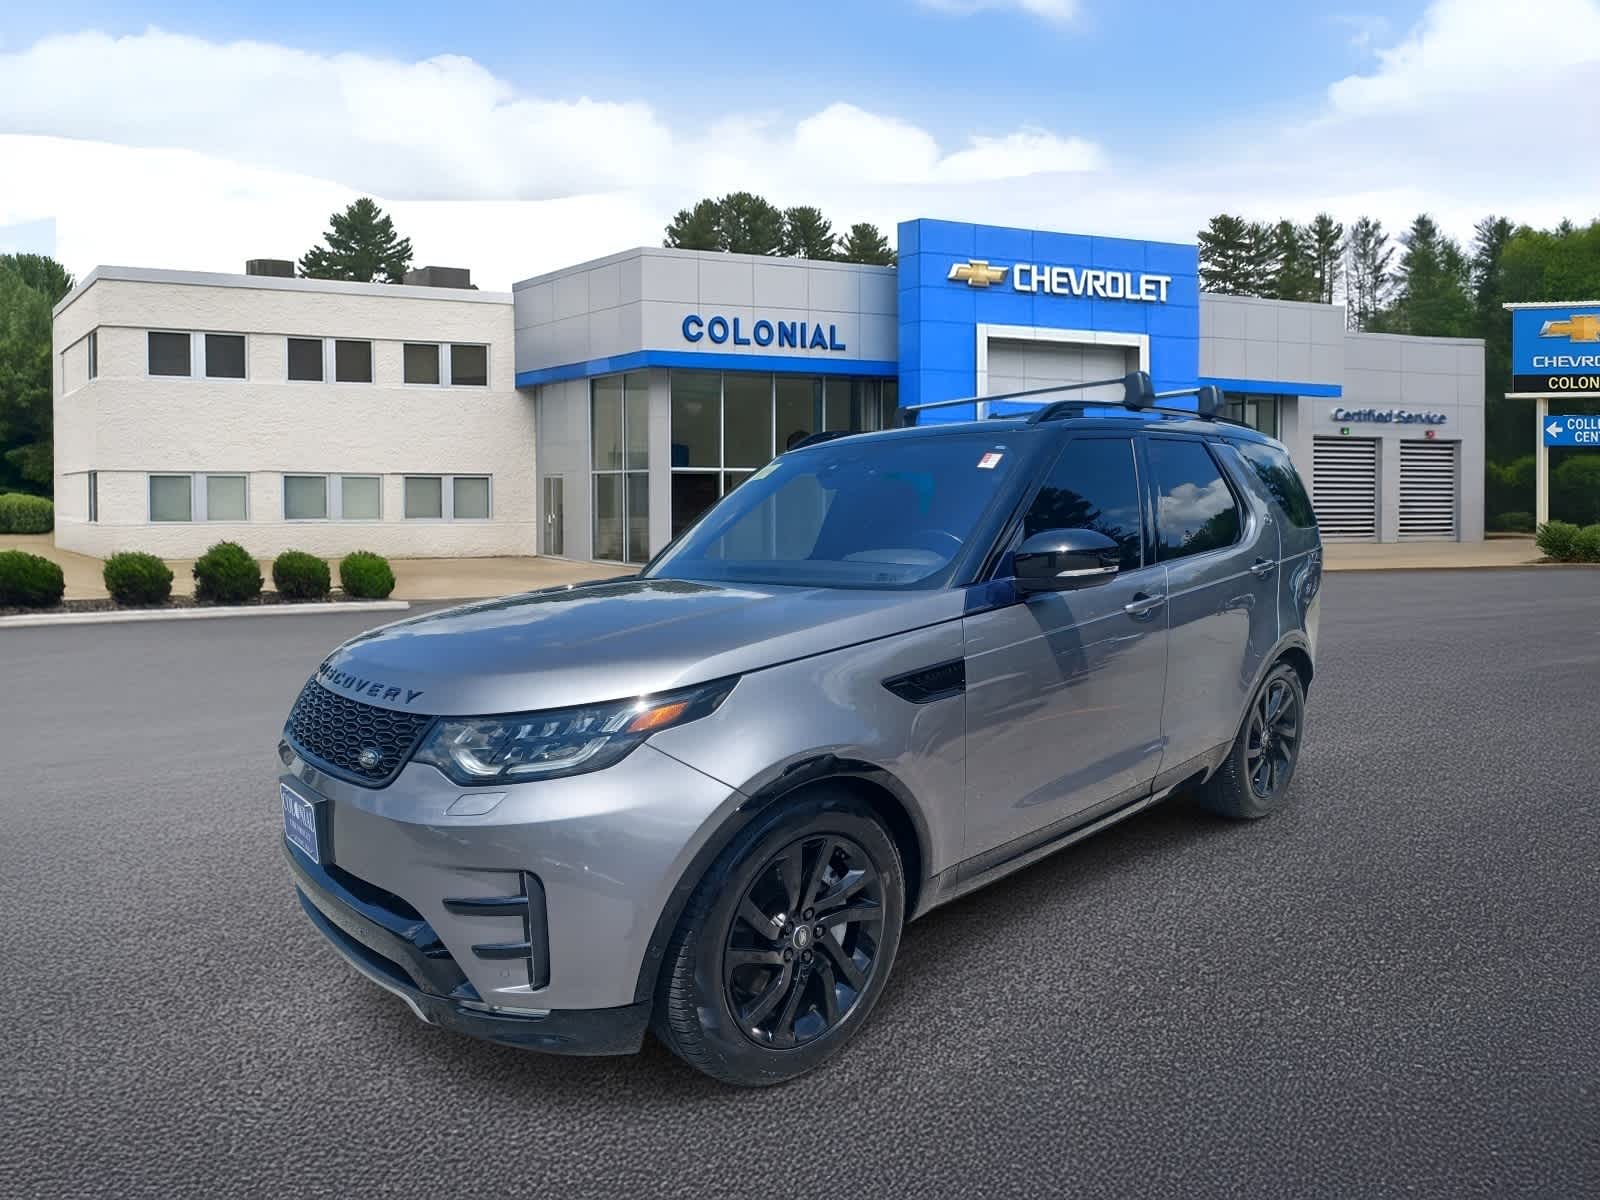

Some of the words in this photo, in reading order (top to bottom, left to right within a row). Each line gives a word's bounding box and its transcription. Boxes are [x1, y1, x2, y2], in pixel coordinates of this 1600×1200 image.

[1012, 262, 1172, 303] CHEVROLET
[682, 314, 846, 351] COLONIAL
[1548, 376, 1600, 389] COLON
[1333, 407, 1393, 424] Certified
[1395, 410, 1447, 425] Service
[1574, 431, 1600, 443] CEN
